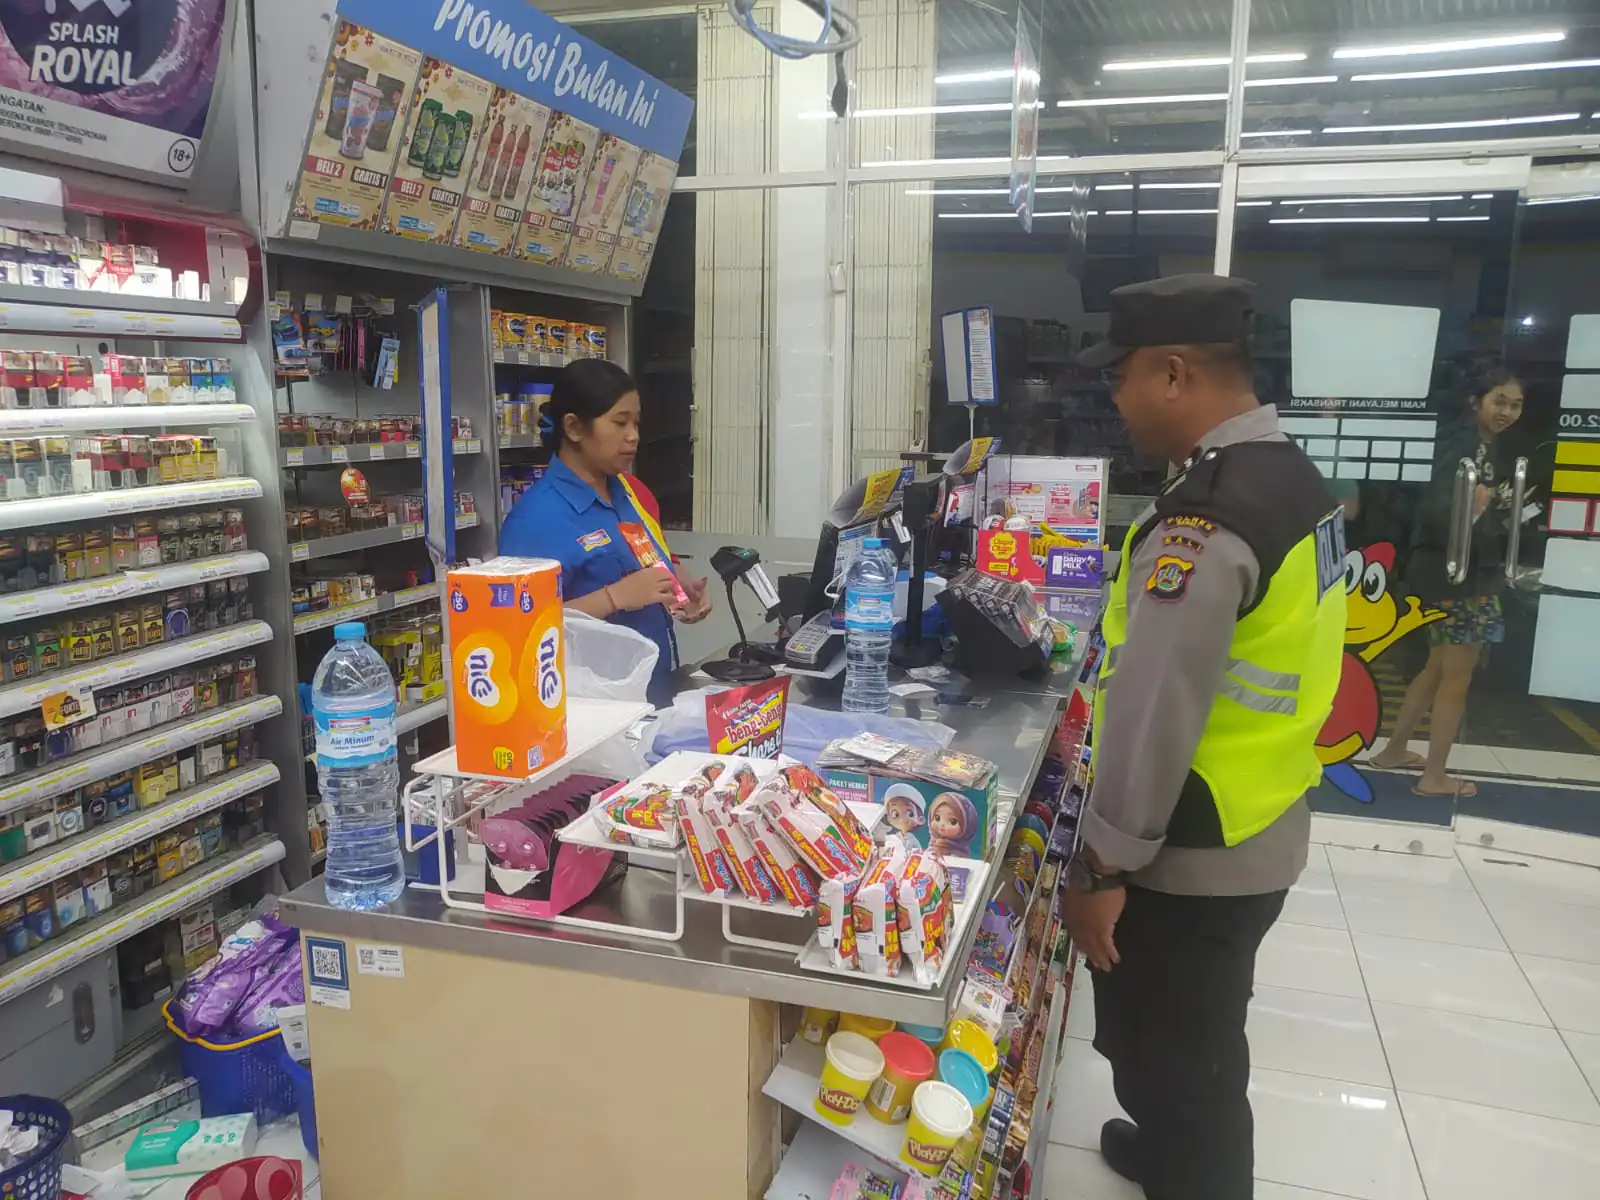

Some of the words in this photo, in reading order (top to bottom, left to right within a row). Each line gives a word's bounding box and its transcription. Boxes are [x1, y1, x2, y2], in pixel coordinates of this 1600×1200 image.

[49, 22, 119, 45] SPLASH
[31, 45, 137, 86] ROYAL
[433, 0, 560, 82] Promosi
[555, 41, 625, 117] Bulan
[626, 79, 660, 129] Ini
[172, 147, 192, 163] 18+
[316, 158, 335, 175] BELI
[334, 165, 342, 177] 2
[353, 167, 381, 186] GRATIS
[380, 175, 386, 187] 1
[401, 180, 417, 195] BELI
[415, 184, 423, 197] 2
[431, 188, 455, 204] GRATIS
[470, 199, 483, 212] BELI
[481, 201, 489, 213] 2
[496, 206, 515, 221] GRATIS
[1063, 556, 1086, 564] DAIRY
[1063, 562, 1081, 570] MILK
[454, 591, 464, 611] 250
[521, 591, 531, 610] 250
[725, 702, 783, 745] beng-beng
[330, 736, 342, 745] Air
[344, 735, 375, 745] Minum
